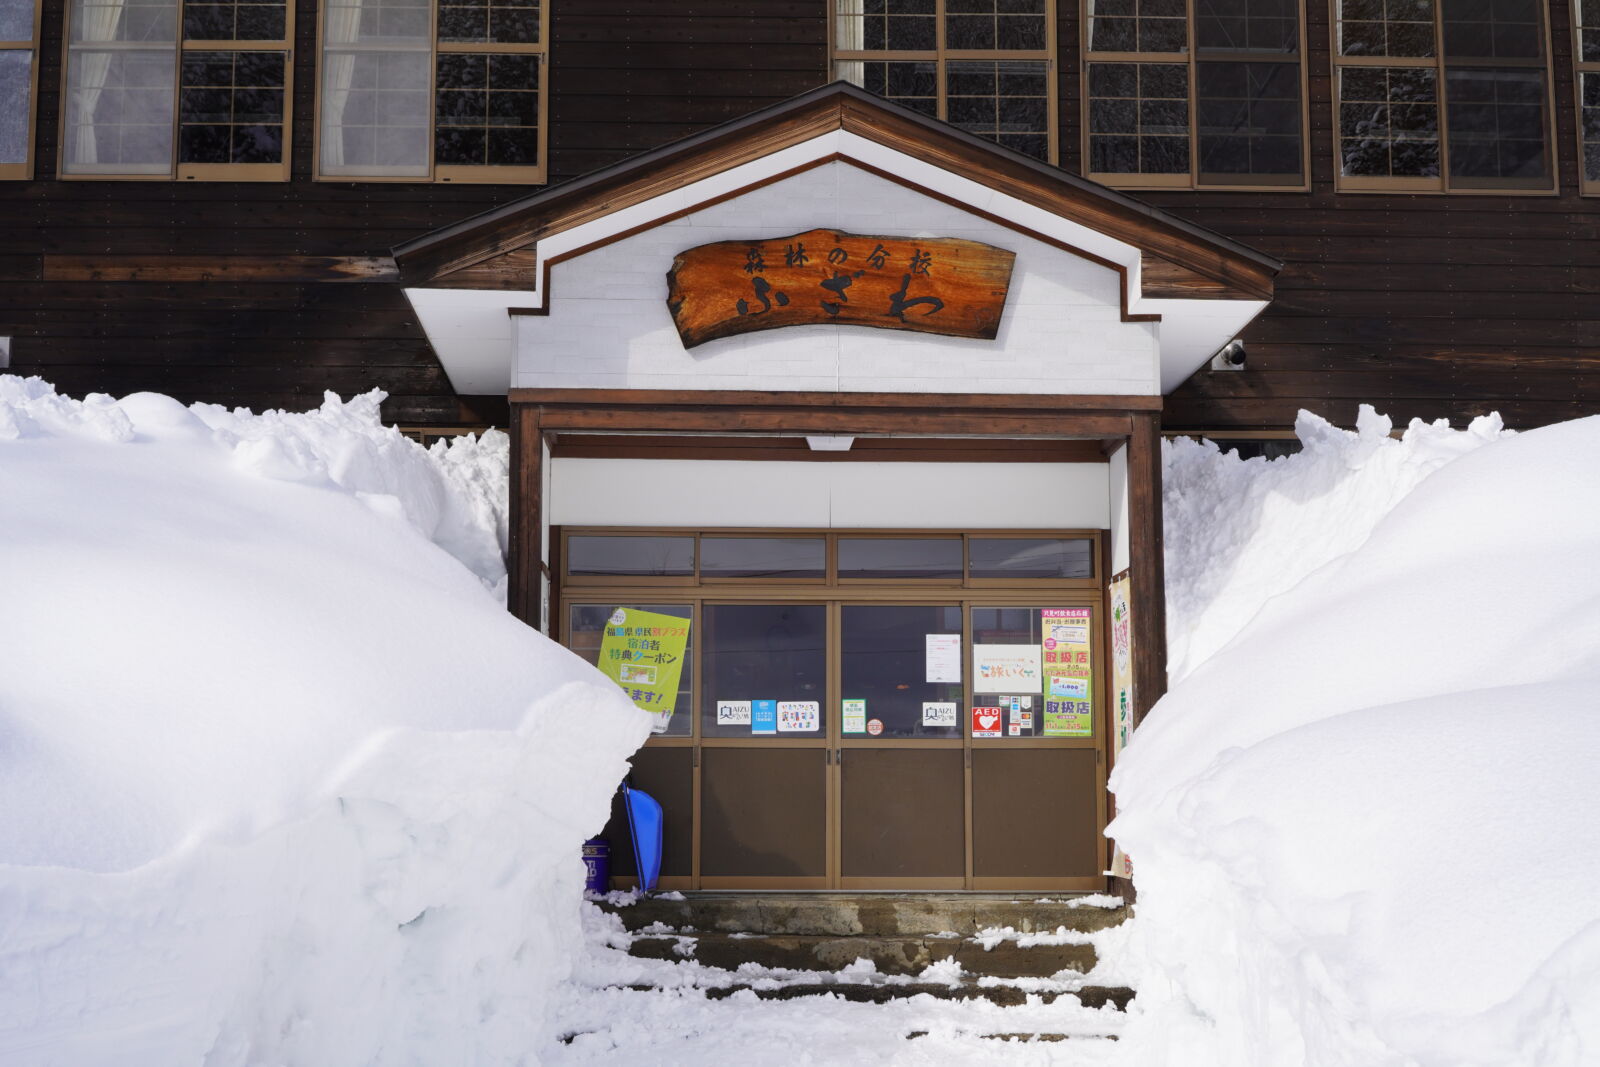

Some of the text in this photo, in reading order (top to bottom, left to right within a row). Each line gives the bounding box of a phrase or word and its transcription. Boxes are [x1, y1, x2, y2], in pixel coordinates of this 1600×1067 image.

[743, 243, 933, 276] 森林の分校
[736, 270, 945, 324] ふざわ
[628, 638, 661, 651] 宿泊者
[609, 648, 677, 664] 特典クーポン
[1045, 652, 1088, 663] 取扱店
[719, 705, 733, 720] 奥
[924, 706, 938, 720] 奥
[1046, 701, 1090, 714] 取扱店
